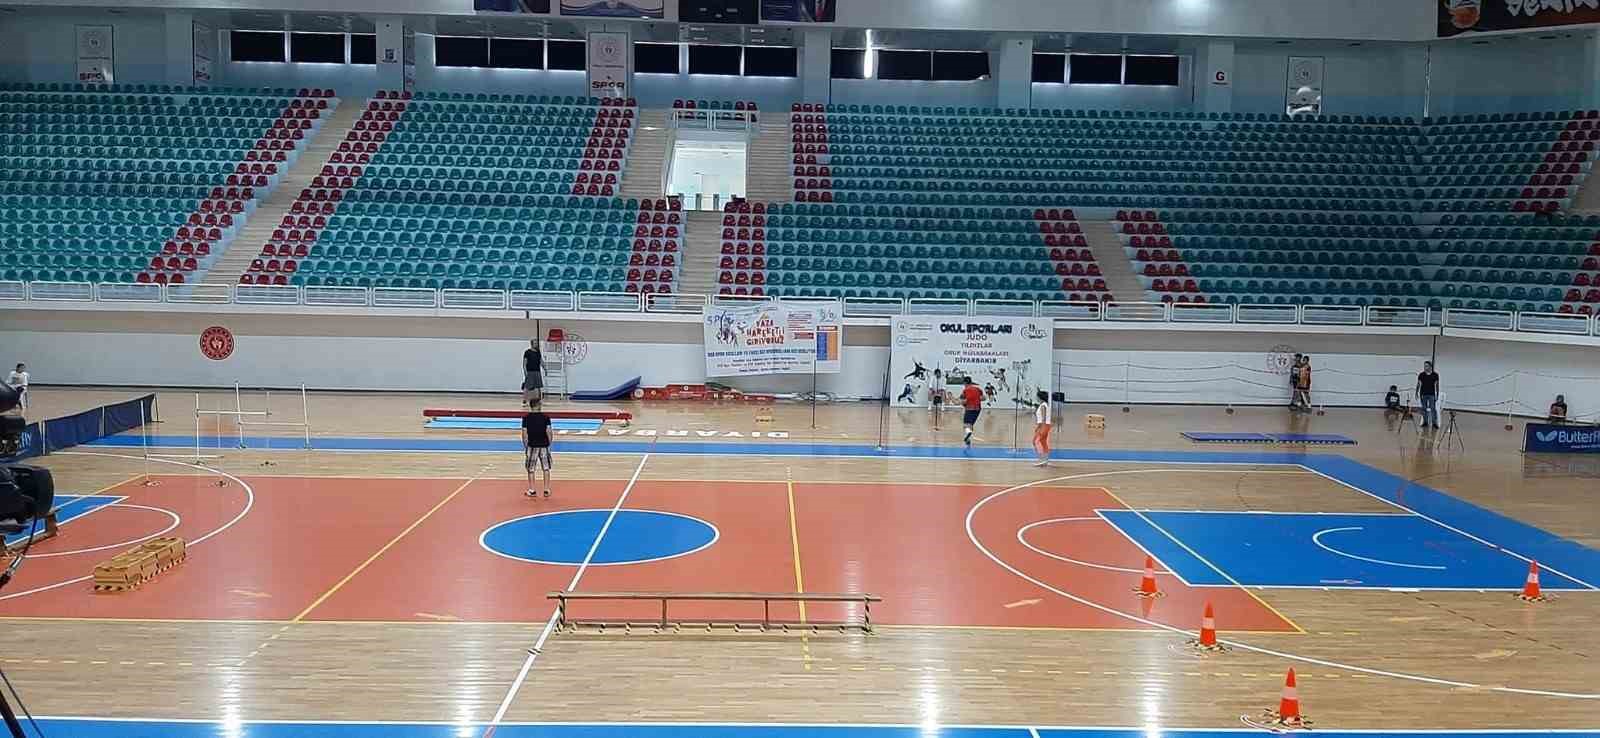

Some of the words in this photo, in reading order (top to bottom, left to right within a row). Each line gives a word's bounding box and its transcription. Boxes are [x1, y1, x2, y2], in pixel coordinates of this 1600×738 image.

[1215, 71, 1225, 81] G
[592, 80, 625, 89] SPOR
[940, 323, 965, 333] OKUL
[966, 323, 1013, 334] SPORLARI
